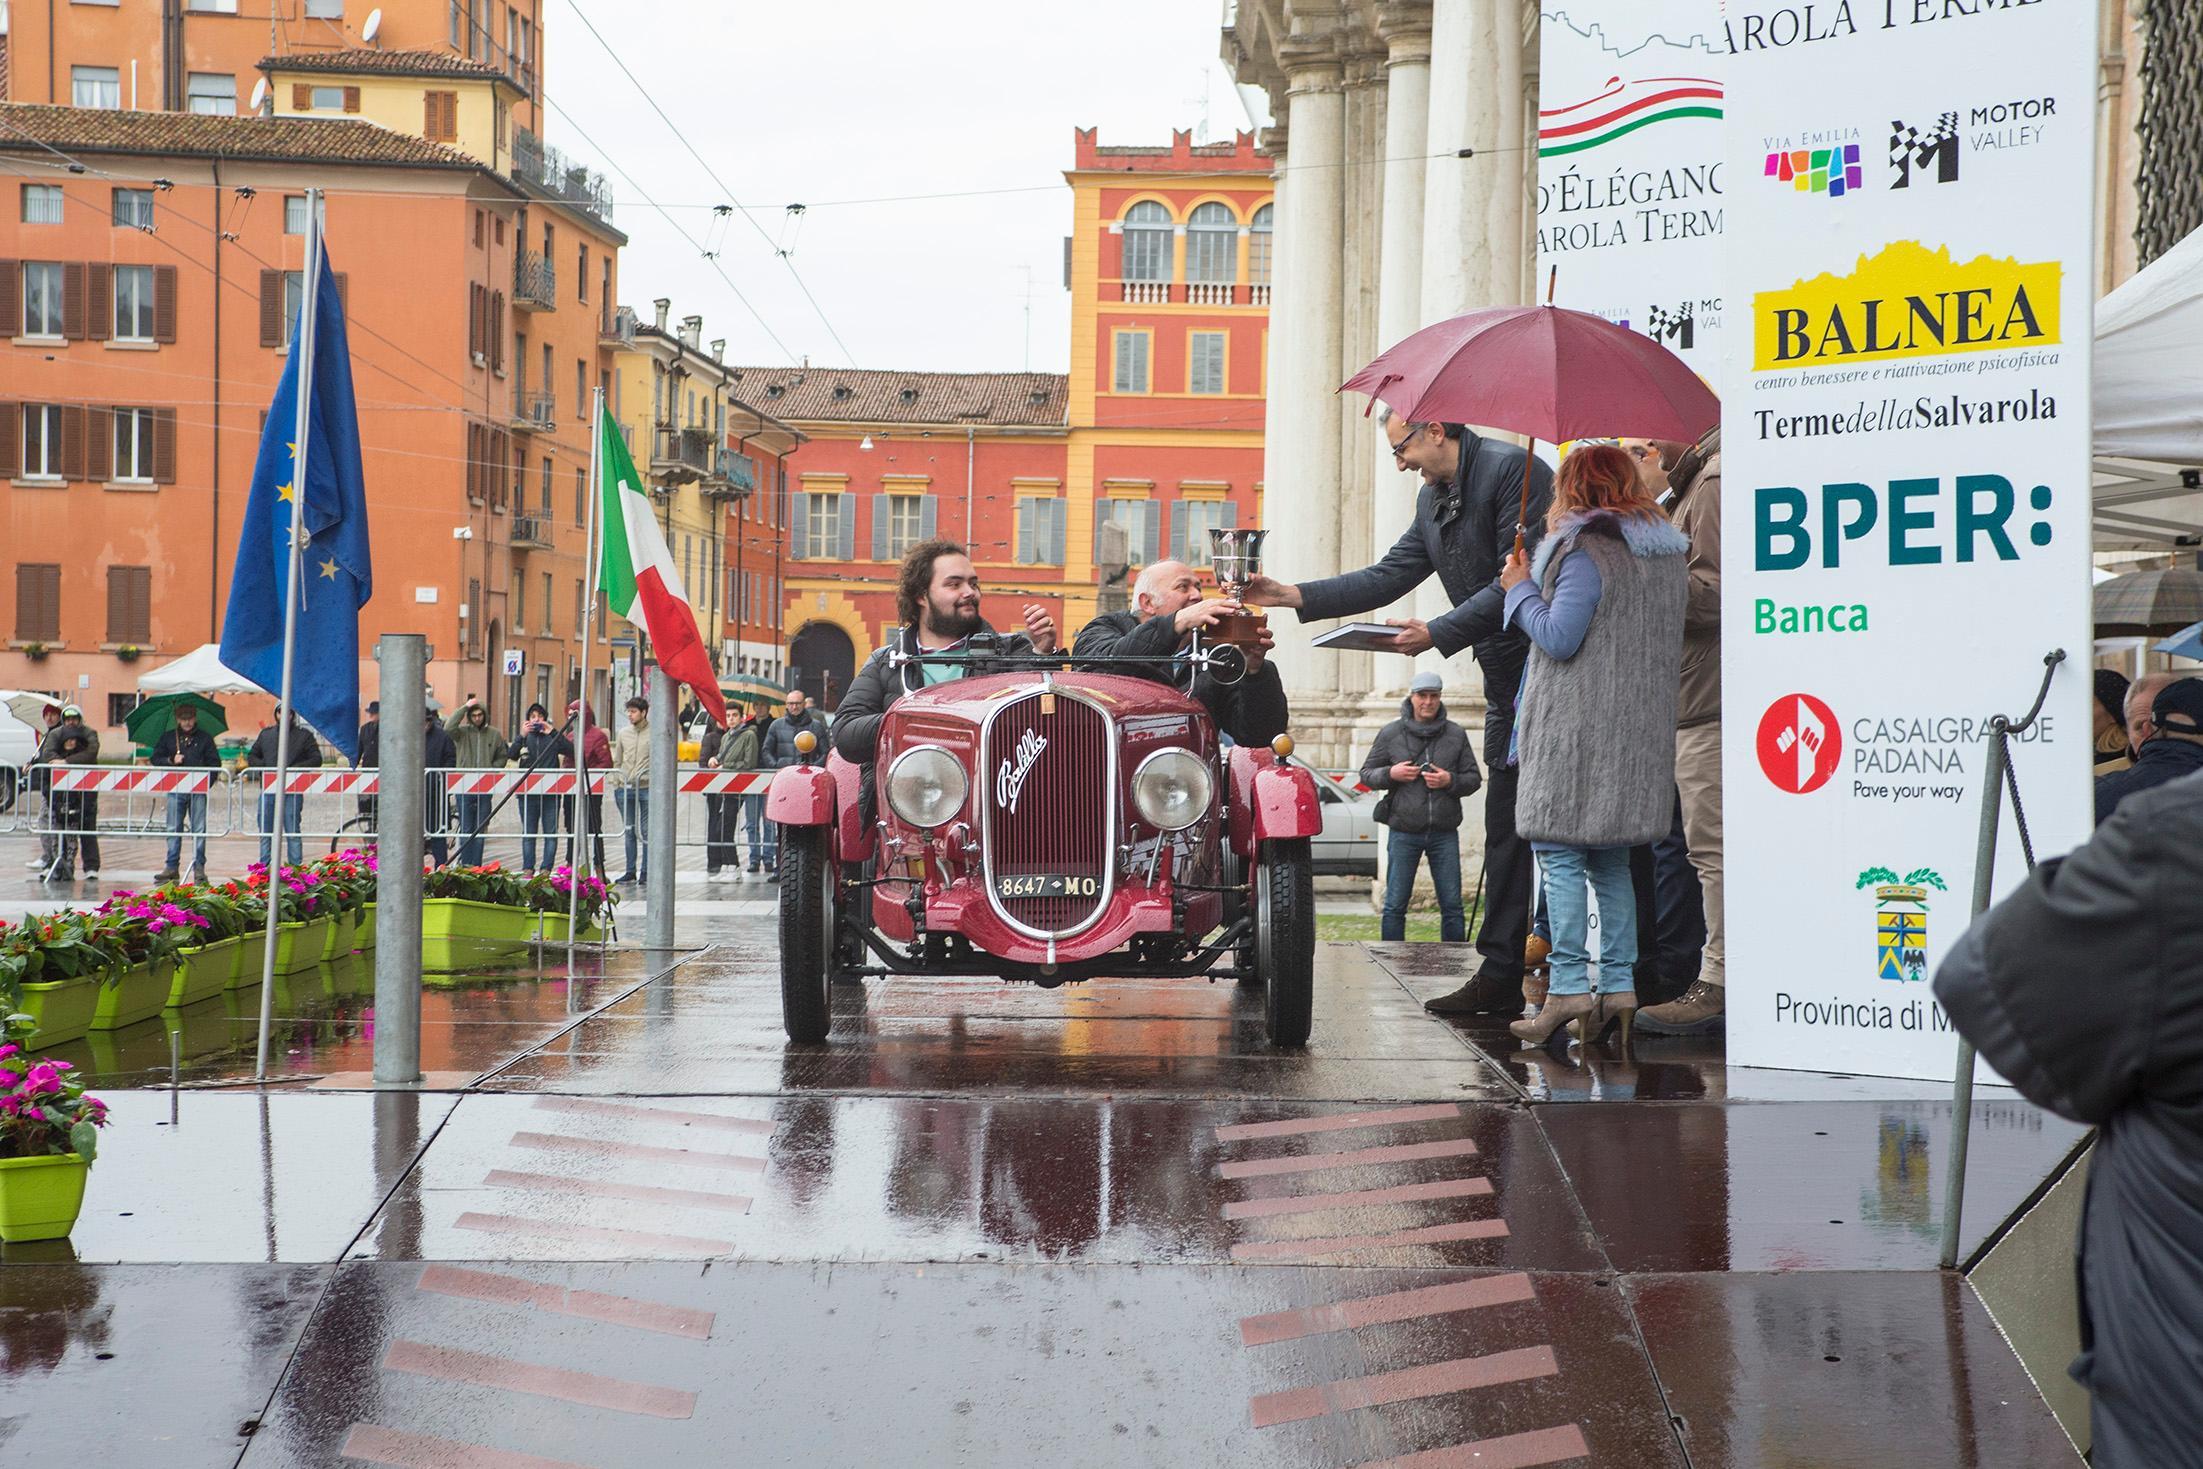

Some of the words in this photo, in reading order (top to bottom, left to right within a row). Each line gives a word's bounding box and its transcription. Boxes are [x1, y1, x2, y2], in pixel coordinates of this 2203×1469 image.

[1971, 96, 2057, 127] MOTOR
[1763, 136, 1792, 150] VIA
[1801, 127, 1861, 146] EMILIA
[1970, 124, 2045, 152] VALLEY
[1773, 283, 2045, 362] BALNEA
[1754, 374, 1797, 390] centro
[1801, 367, 1869, 387] benessere
[1872, 367, 1881, 381] e
[1884, 359, 1975, 379] riattivazione
[1978, 351, 2060, 375] psicofisica
[1754, 597, 1869, 635] Banca
[997, 728, 1048, 815] Balilla
[1854, 748, 1965, 774] PADANA
[1854, 780, 1888, 798] Pave
[1892, 786, 1926, 803] your
[1930, 786, 1964, 803] way
[1002, 876, 1046, 897] 8647
[1064, 878, 1096, 896] MO
[1776, 992, 1893, 1029] Provincia
[1900, 1000, 1923, 1031] di
